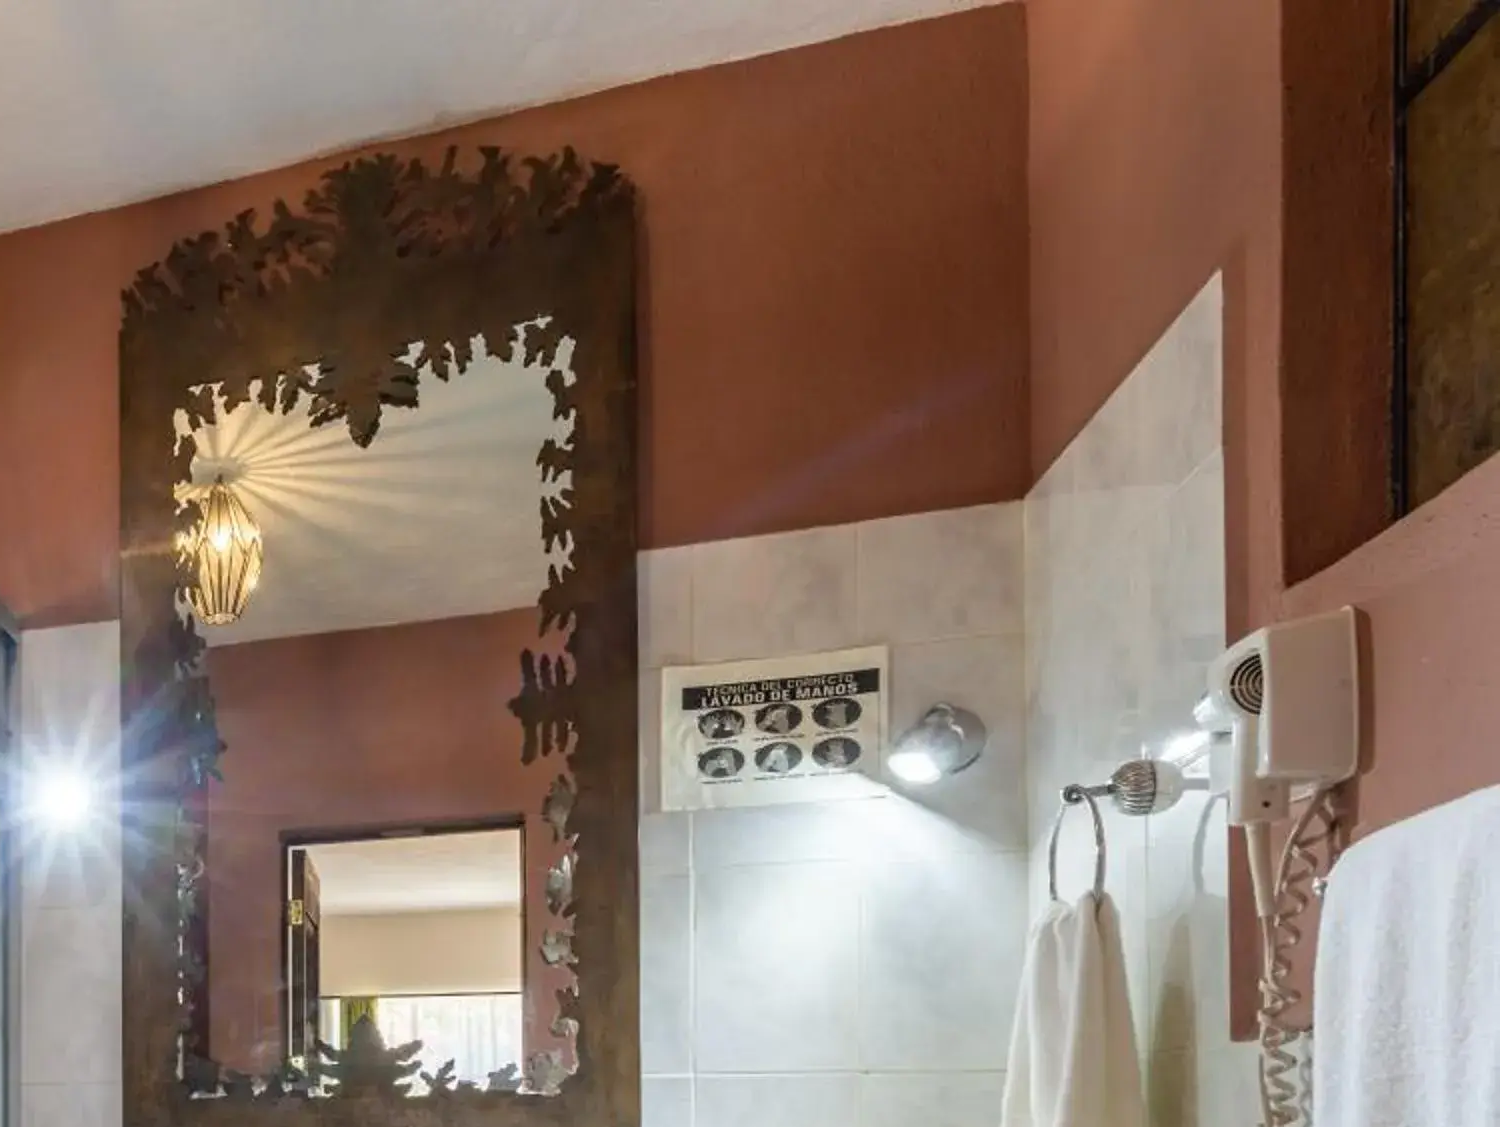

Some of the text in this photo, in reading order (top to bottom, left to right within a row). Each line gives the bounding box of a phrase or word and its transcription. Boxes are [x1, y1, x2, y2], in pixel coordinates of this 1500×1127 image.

[701, 682, 858, 708] LAVADO DE MANOS
